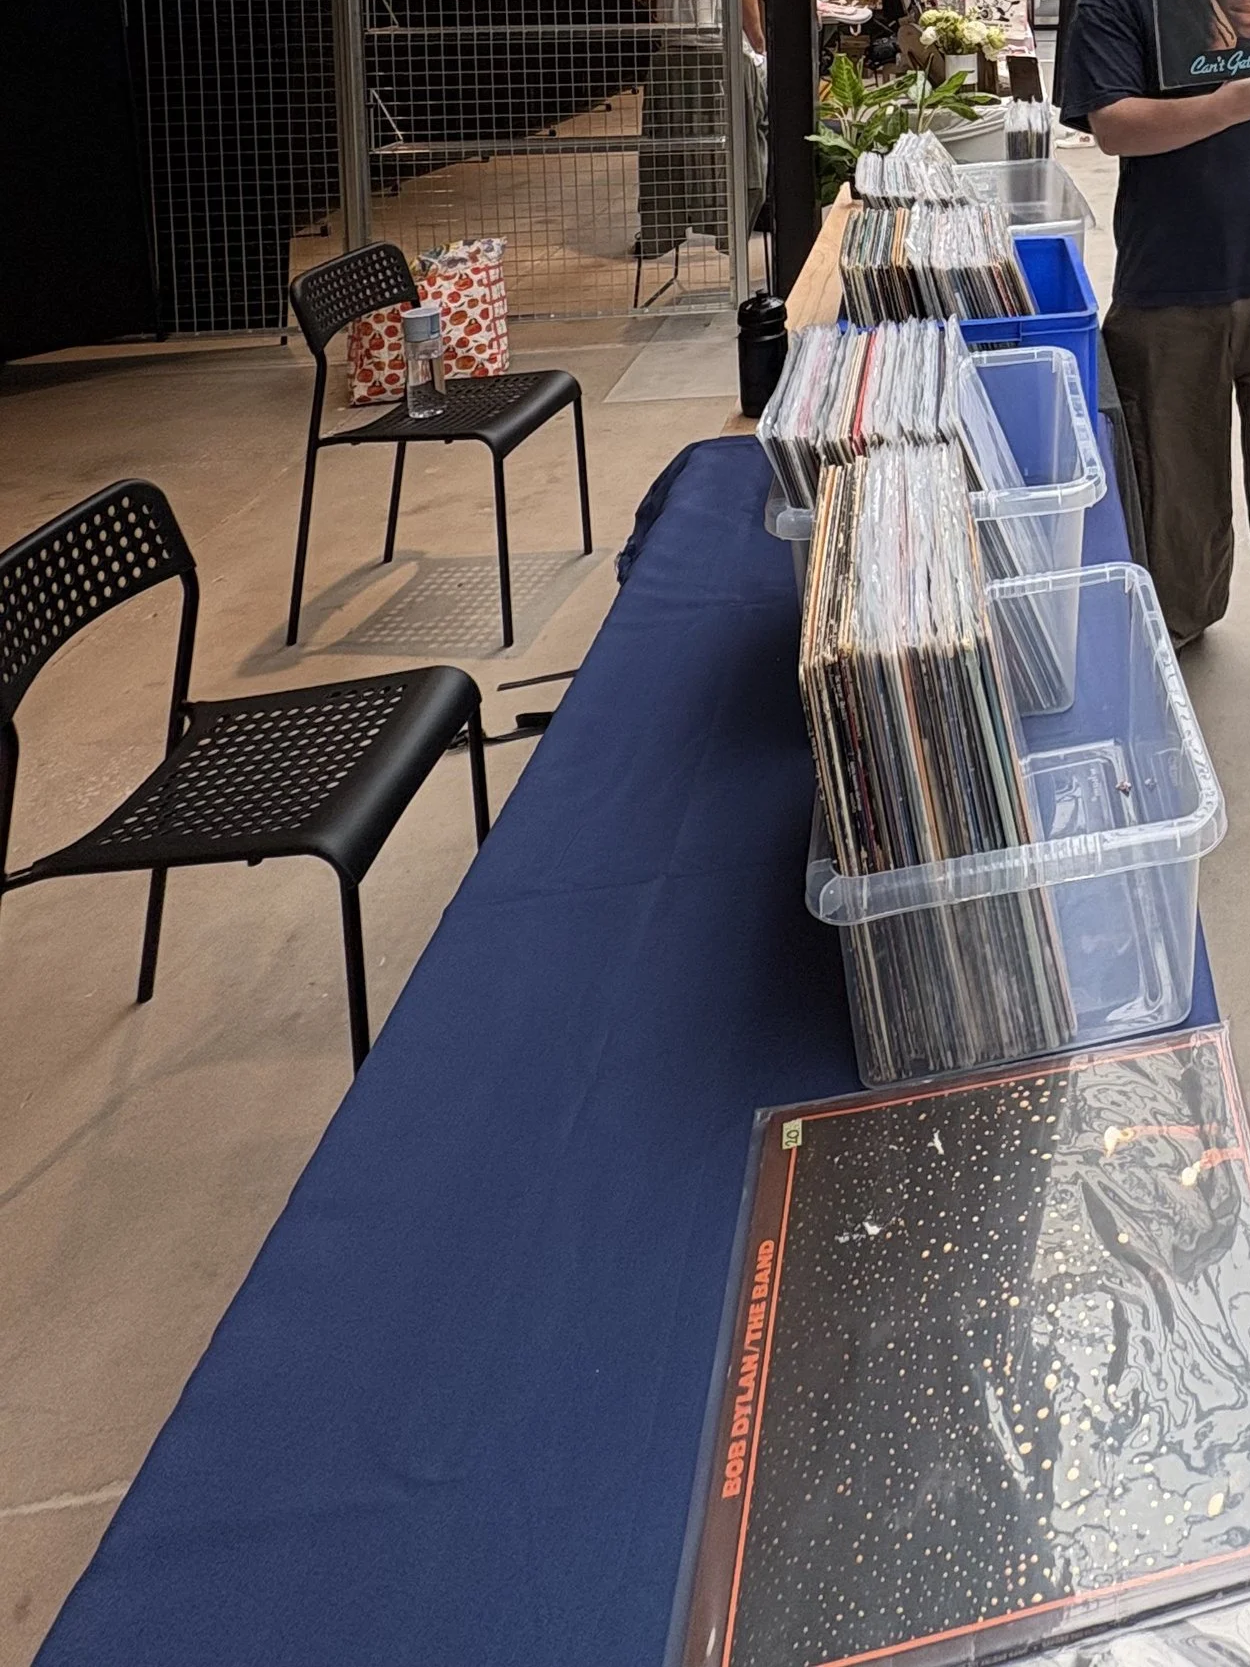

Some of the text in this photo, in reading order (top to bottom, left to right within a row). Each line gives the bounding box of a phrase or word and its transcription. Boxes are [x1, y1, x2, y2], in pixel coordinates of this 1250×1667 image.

[1190, 55, 1225, 74] Can't
[785, 1129, 800, 1147] 20
[722, 1439, 747, 1498] BOB
[752, 1239, 775, 1300] BAND
